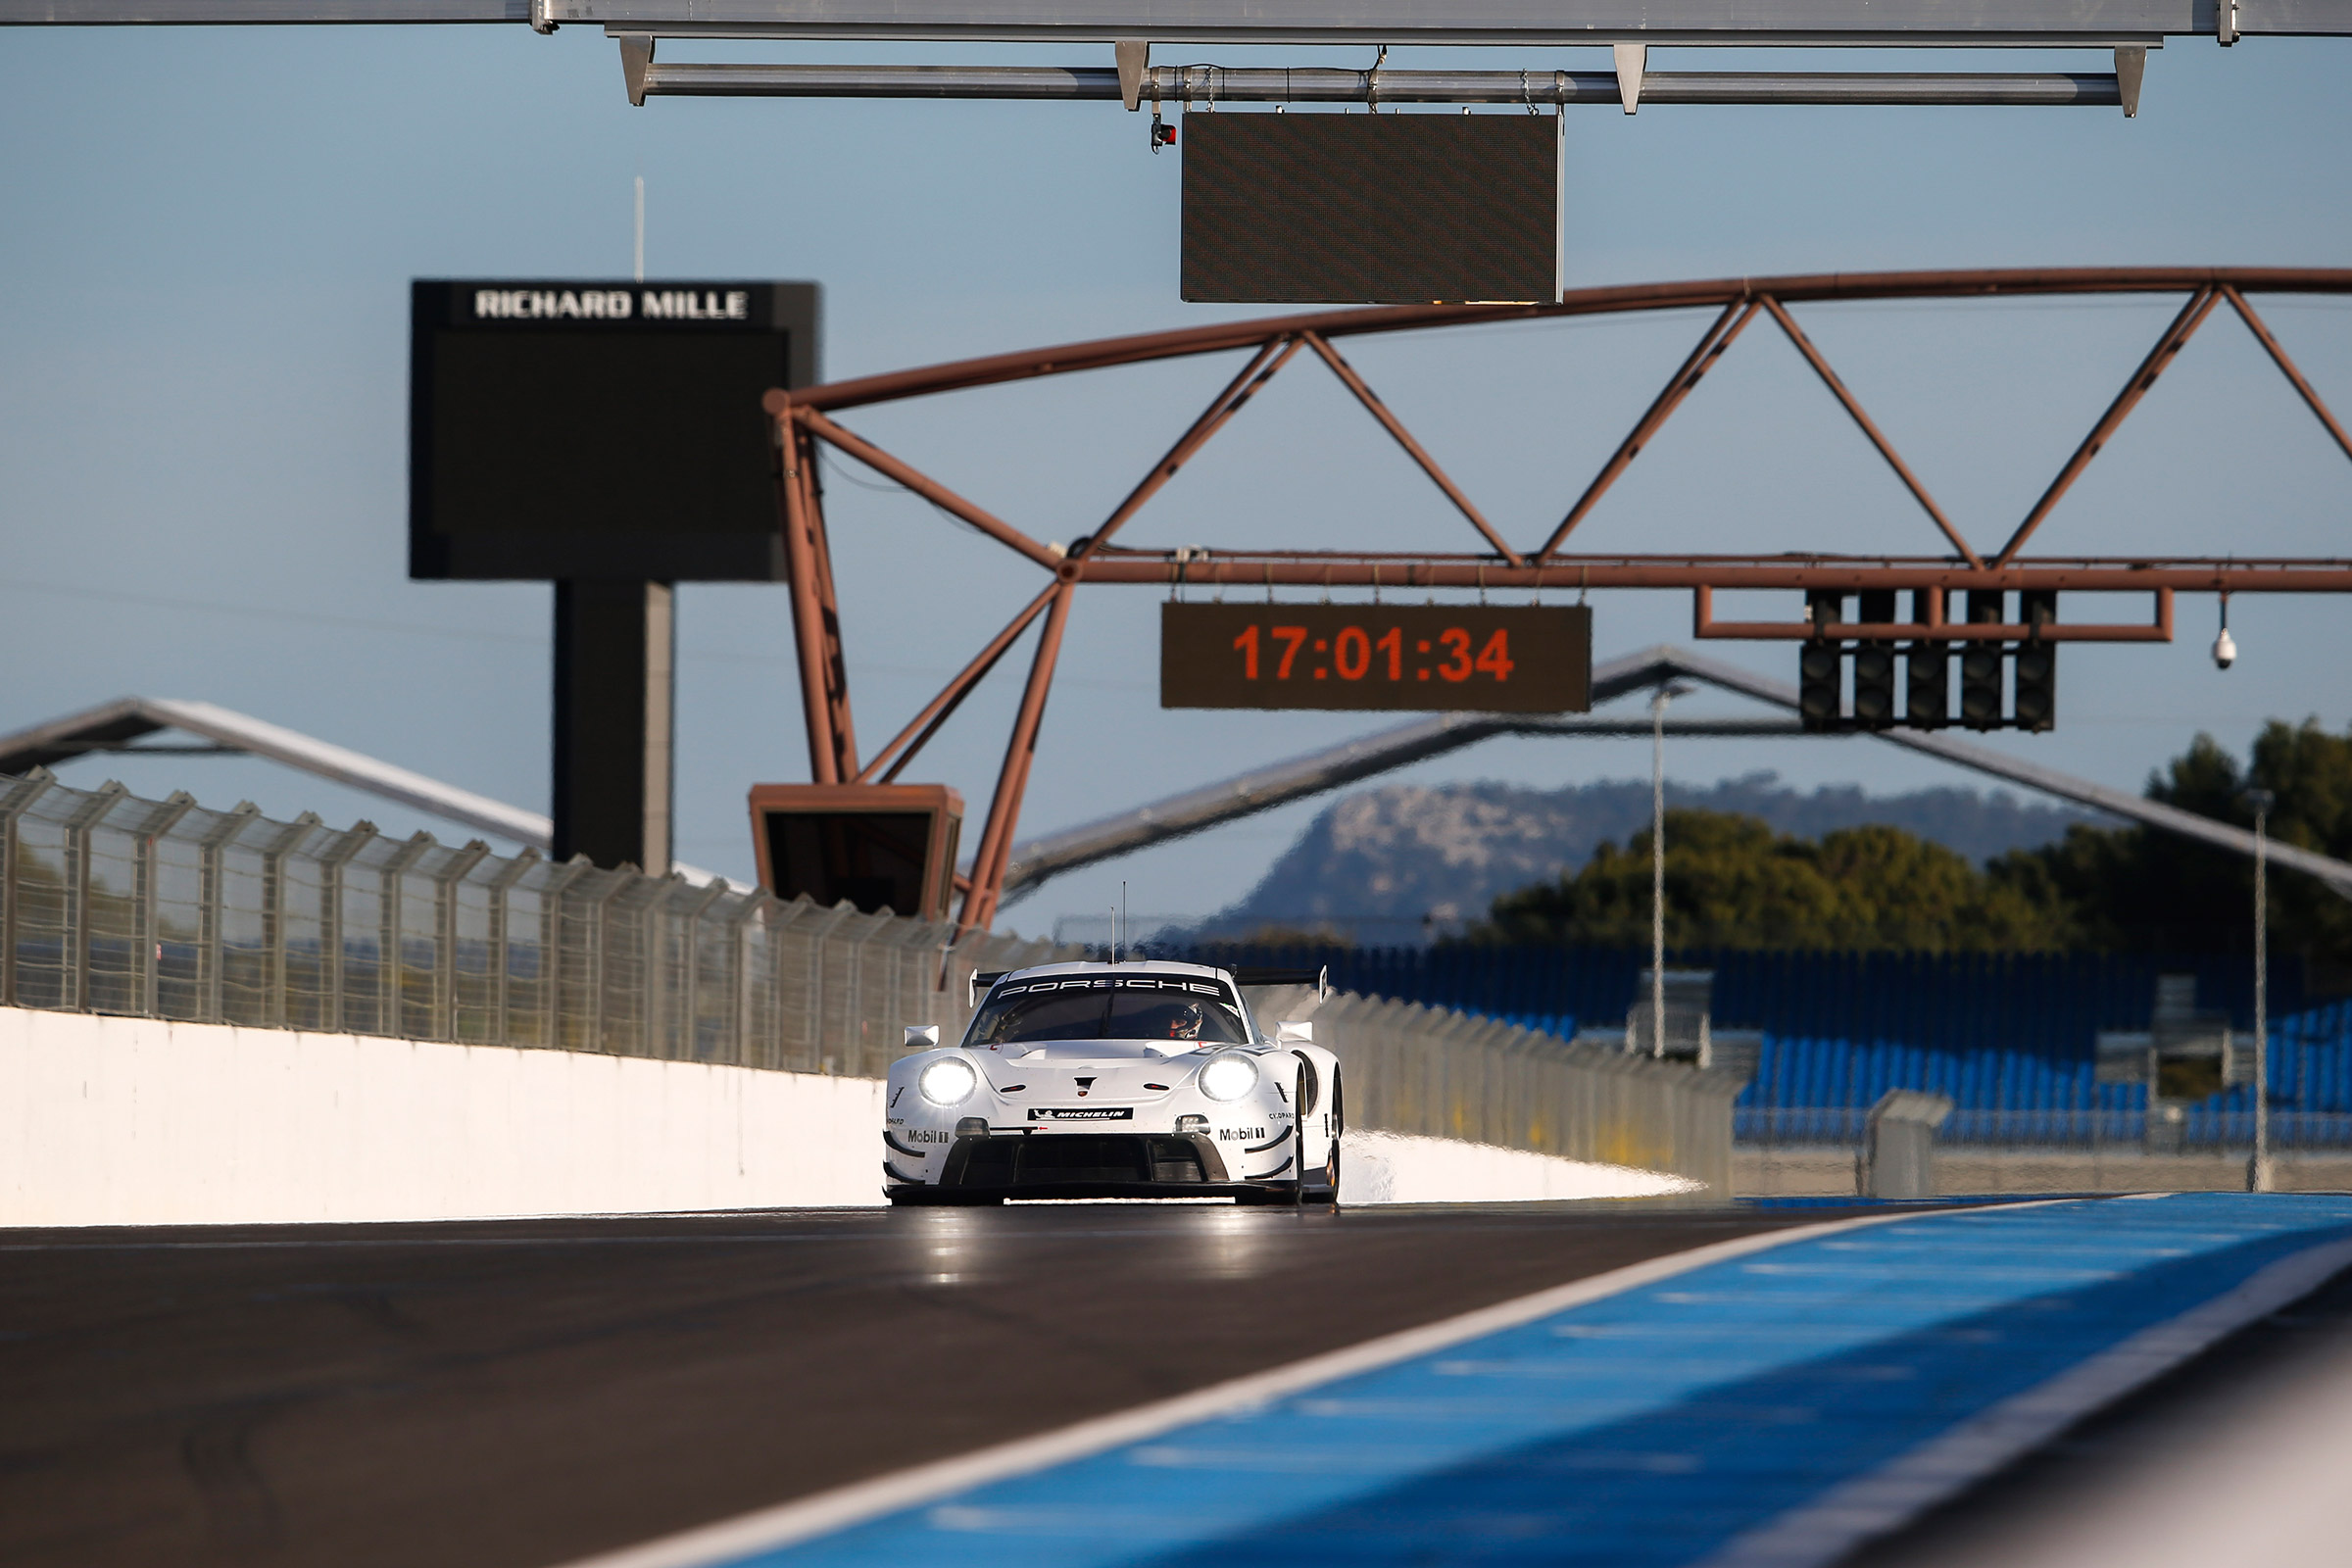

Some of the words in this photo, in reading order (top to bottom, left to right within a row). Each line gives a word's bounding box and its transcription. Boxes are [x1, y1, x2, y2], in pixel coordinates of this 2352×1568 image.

[474, 290, 633, 319] RICHARD
[642, 291, 749, 320] MILLE
[1233, 625, 1515, 682] 17:01:34
[998, 979, 1221, 1000] PORSCHE
[907, 1130, 937, 1143] Mobil
[1219, 1127, 1253, 1141] Mobil
